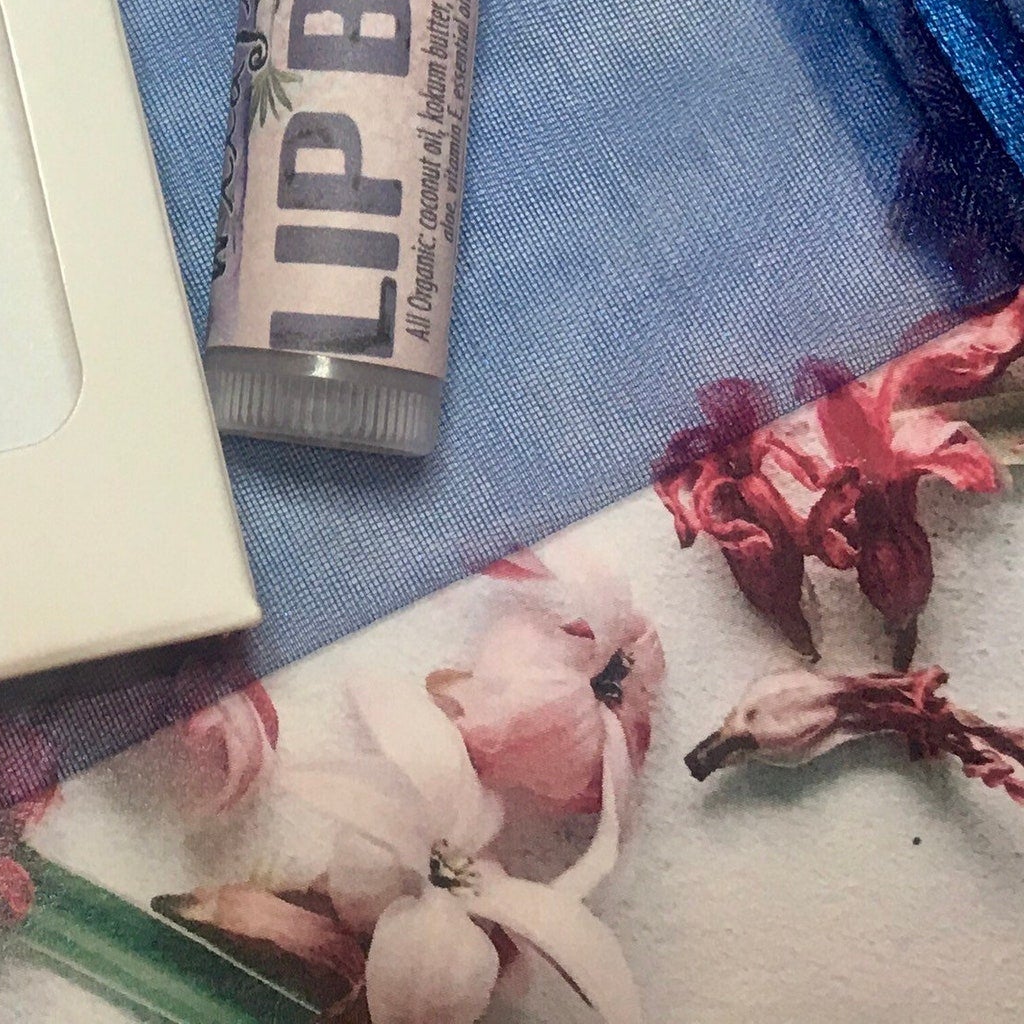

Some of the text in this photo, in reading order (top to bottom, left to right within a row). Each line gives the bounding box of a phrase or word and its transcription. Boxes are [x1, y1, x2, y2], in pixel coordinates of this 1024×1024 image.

[421, 0, 454, 60] butter,
[452, 17, 469, 100] essential
[417, 60, 447, 125] kokum
[416, 128, 449, 155] oil,
[419, 156, 441, 230] coconut
[270, 112, 402, 359] LIP
[407, 233, 438, 311] Organic:
[405, 313, 431, 343] All
